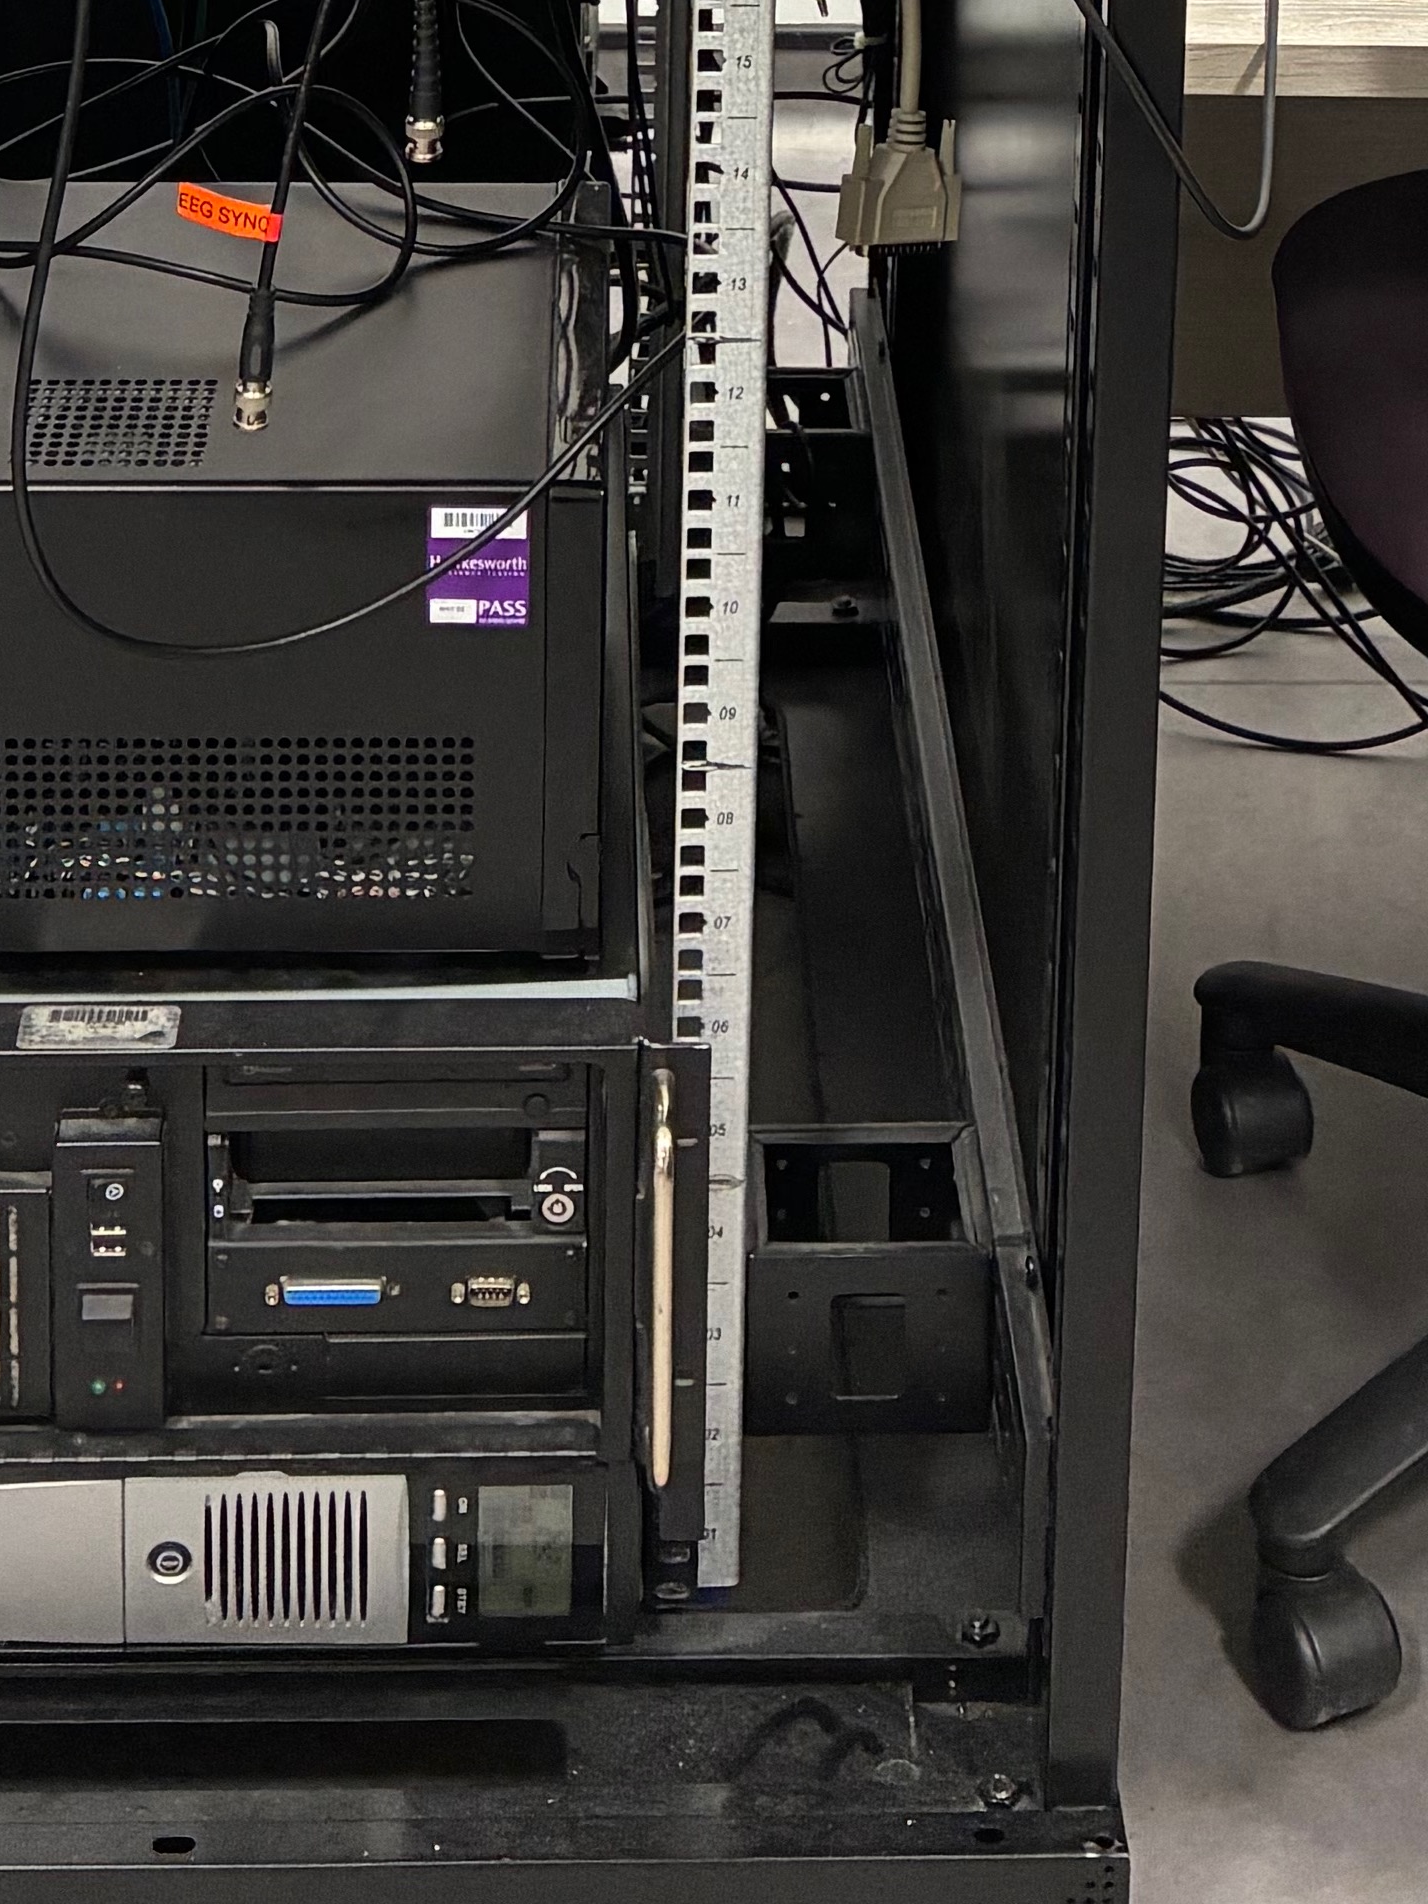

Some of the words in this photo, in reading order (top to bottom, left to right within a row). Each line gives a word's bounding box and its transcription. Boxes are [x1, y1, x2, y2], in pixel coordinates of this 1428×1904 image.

[735, 55, 752, 69] 15
[733, 167, 749, 181] 14
[178, 192, 213, 218] EEG
[731, 277, 747, 291] 13
[727, 386, 744, 400] 12
[726, 494, 739, 507] 11
[429, 555, 527, 571] Hkesworth
[478, 599, 527, 617] PASS
[722, 600, 739, 614] 10
[718, 706, 737, 720] 09
[716, 812, 734, 826] 08
[714, 915, 732, 929] 07
[711, 1019, 729, 1033] 06
